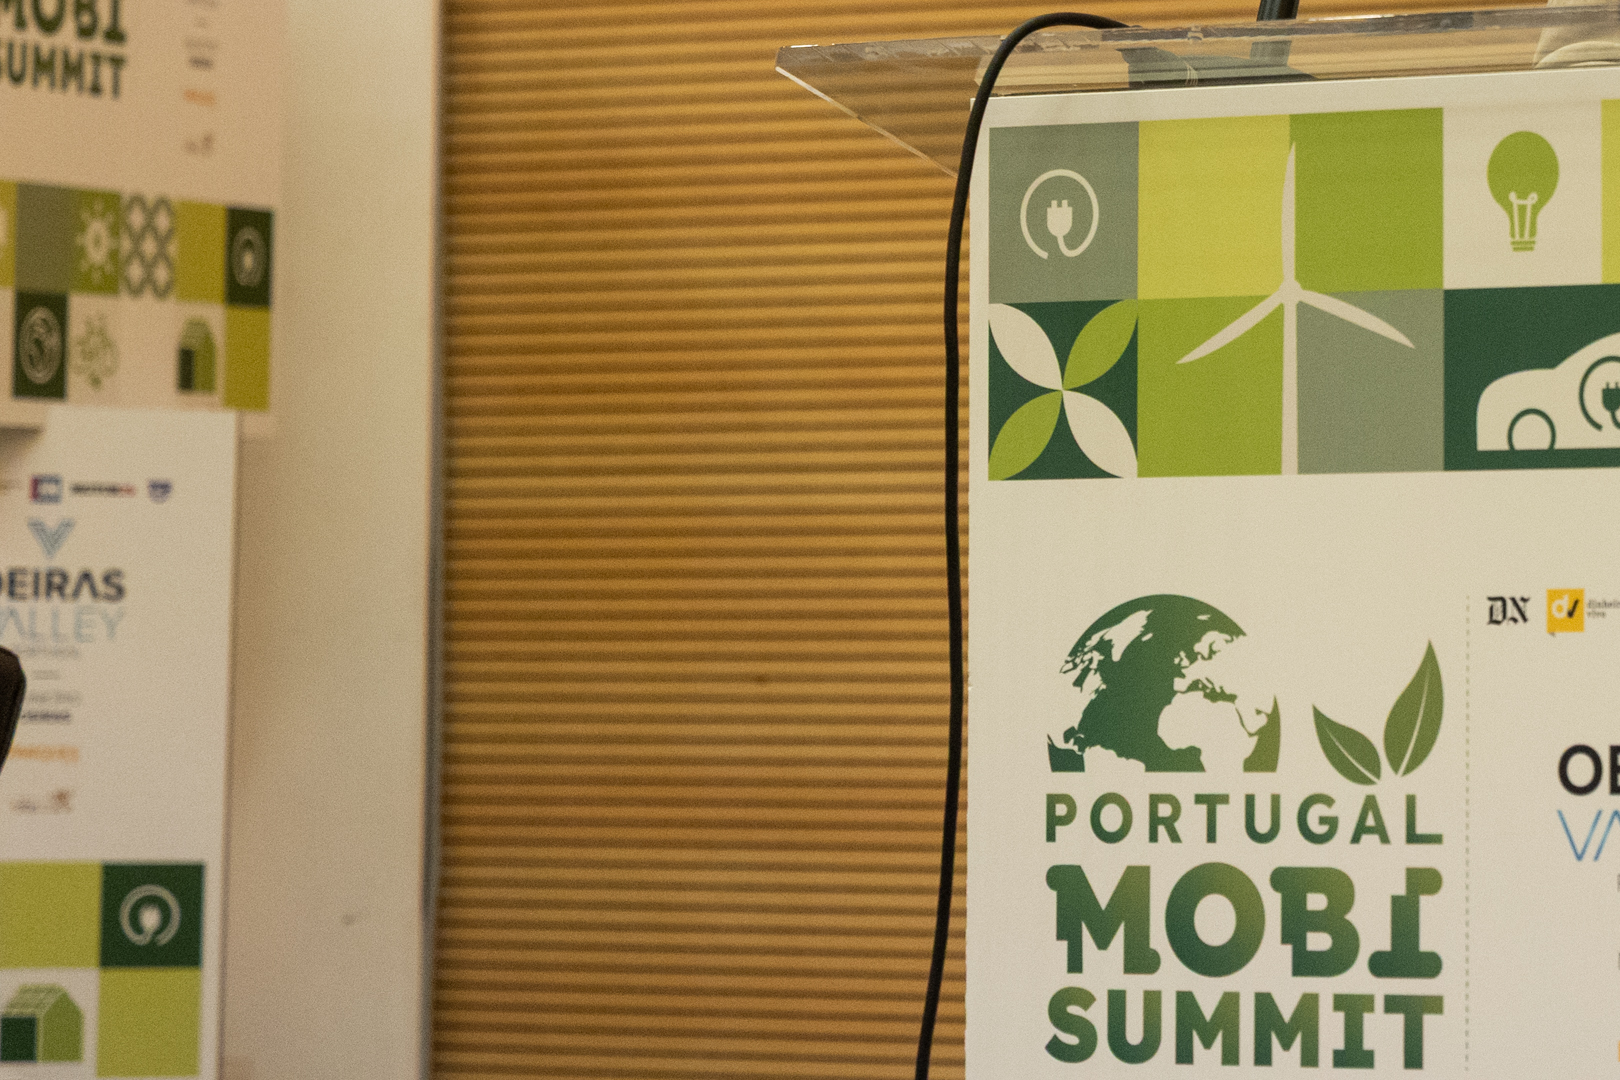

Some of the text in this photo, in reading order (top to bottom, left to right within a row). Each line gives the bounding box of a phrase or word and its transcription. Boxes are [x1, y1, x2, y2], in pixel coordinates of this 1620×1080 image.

[0, 41, 127, 99] UMMIT
[0, 567, 126, 603] EIRAS
[1487, 595, 1530, 625] DN
[0, 605, 125, 644] ALLEY
[1046, 792, 1444, 845] PORTUGAL
[1046, 862, 1443, 979] MOBI
[1045, 986, 1444, 1070] SUMMIT
